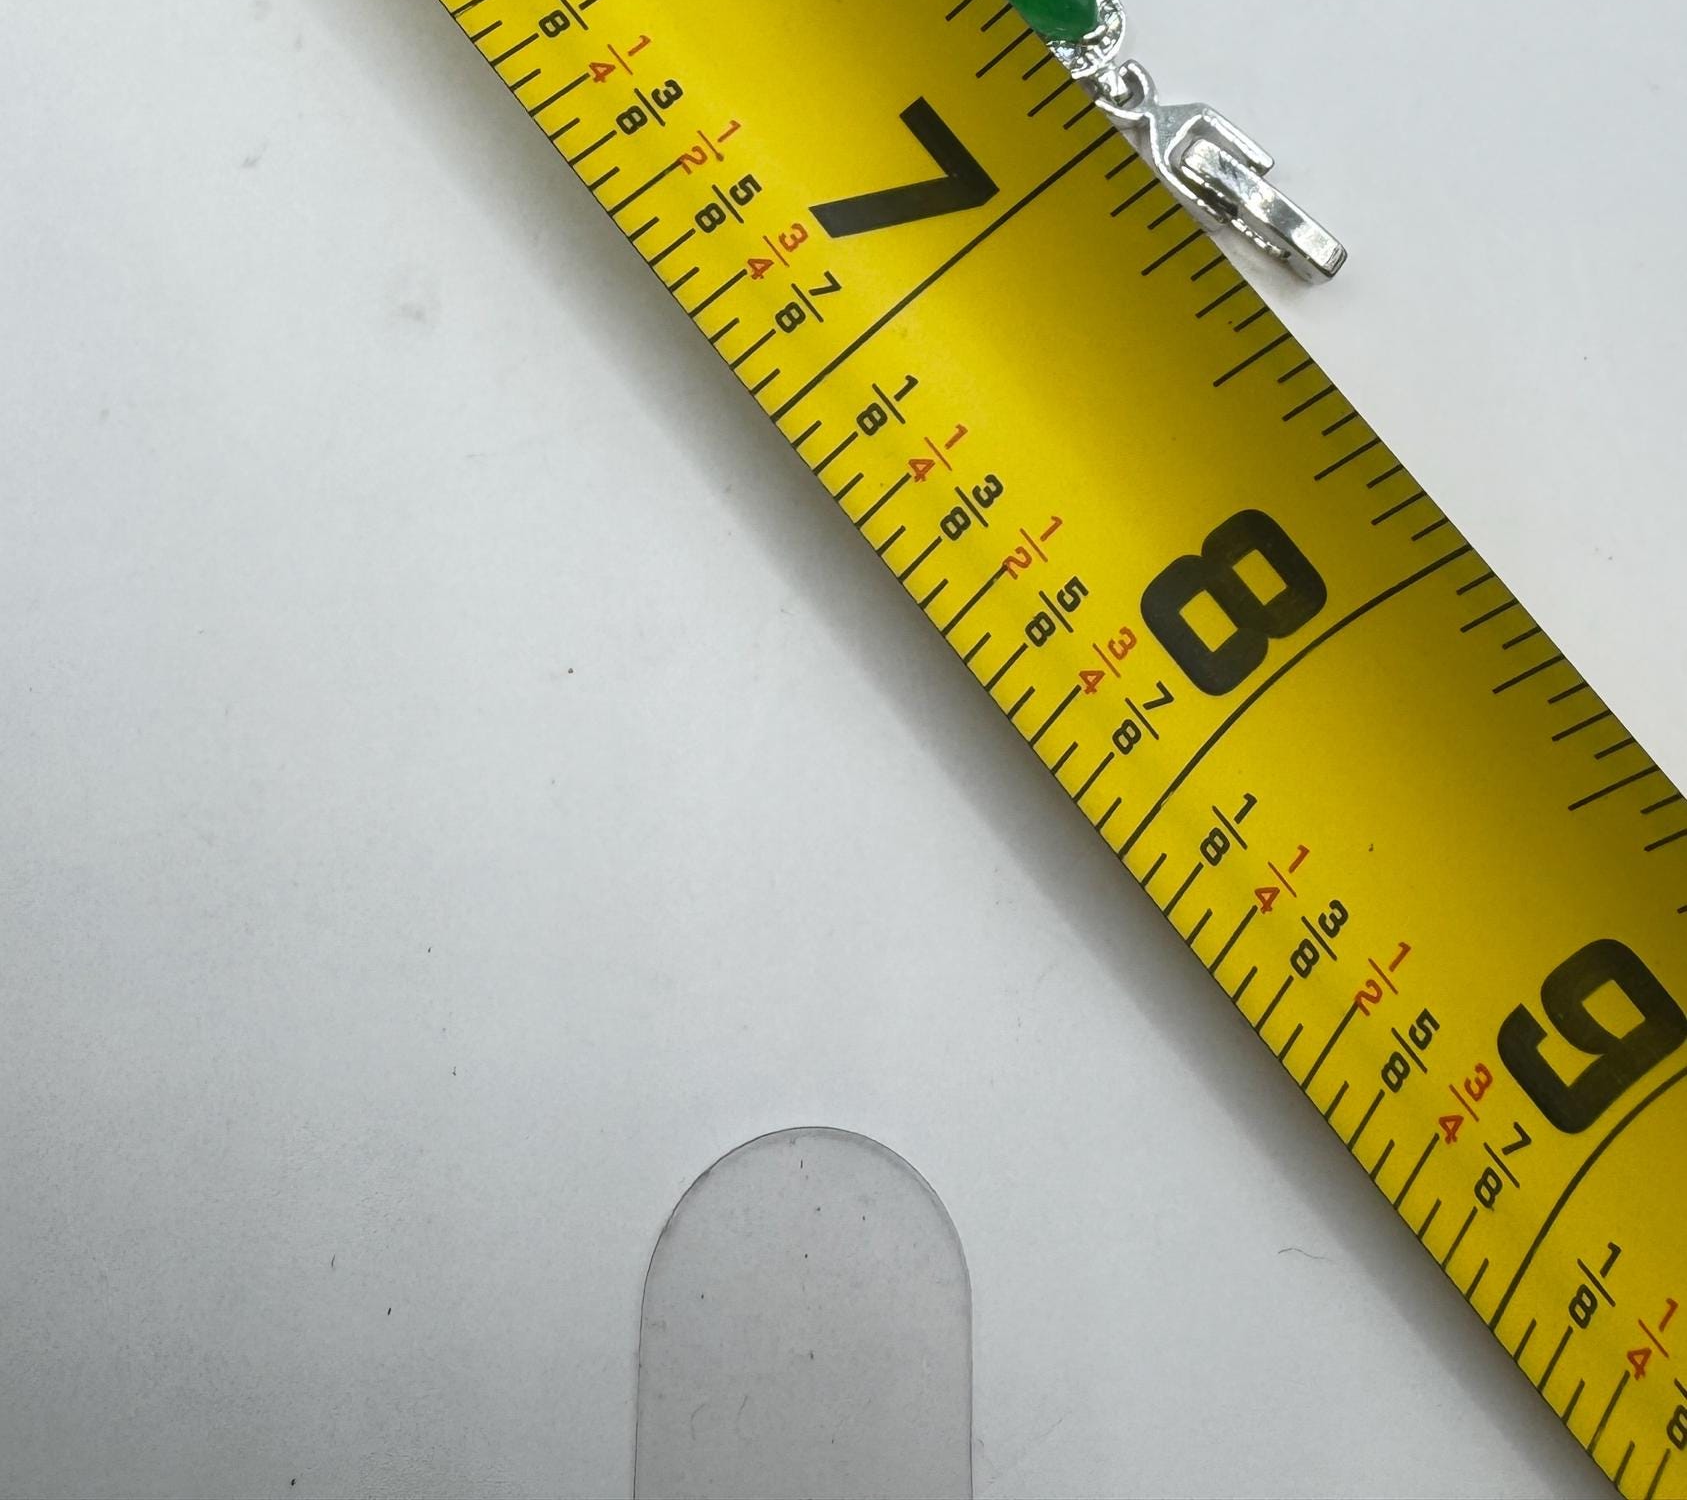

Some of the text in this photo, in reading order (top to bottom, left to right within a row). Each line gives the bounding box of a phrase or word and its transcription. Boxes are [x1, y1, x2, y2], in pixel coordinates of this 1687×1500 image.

[808, 96, 1000, 238] 7
[1140, 508, 1327, 697] 8
[1496, 938, 1687, 1134] 9
